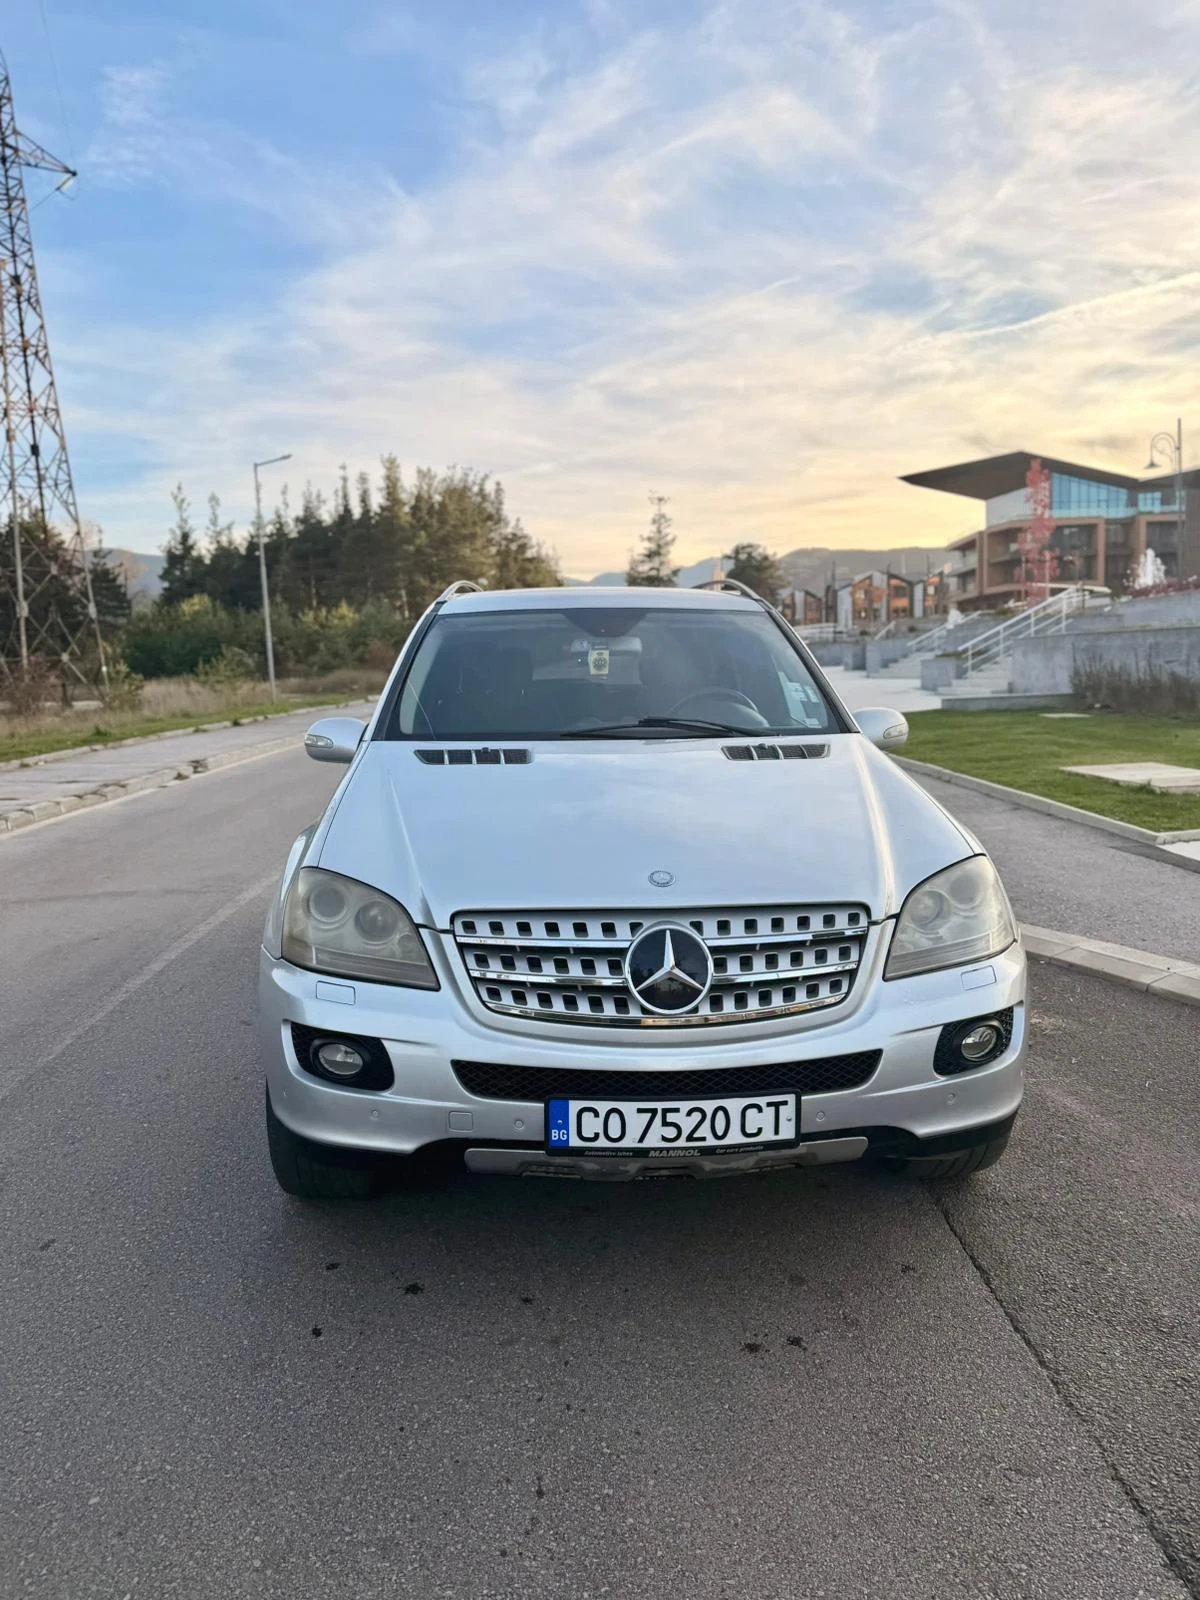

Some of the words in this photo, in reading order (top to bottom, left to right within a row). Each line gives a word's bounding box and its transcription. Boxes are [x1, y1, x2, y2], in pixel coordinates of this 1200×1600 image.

[576, 1106, 626, 1143] CO
[636, 1105, 731, 1144] 7520
[740, 1100, 789, 1138] CT
[551, 1129, 568, 1141] BG
[648, 1149, 701, 1158] MANNOL
